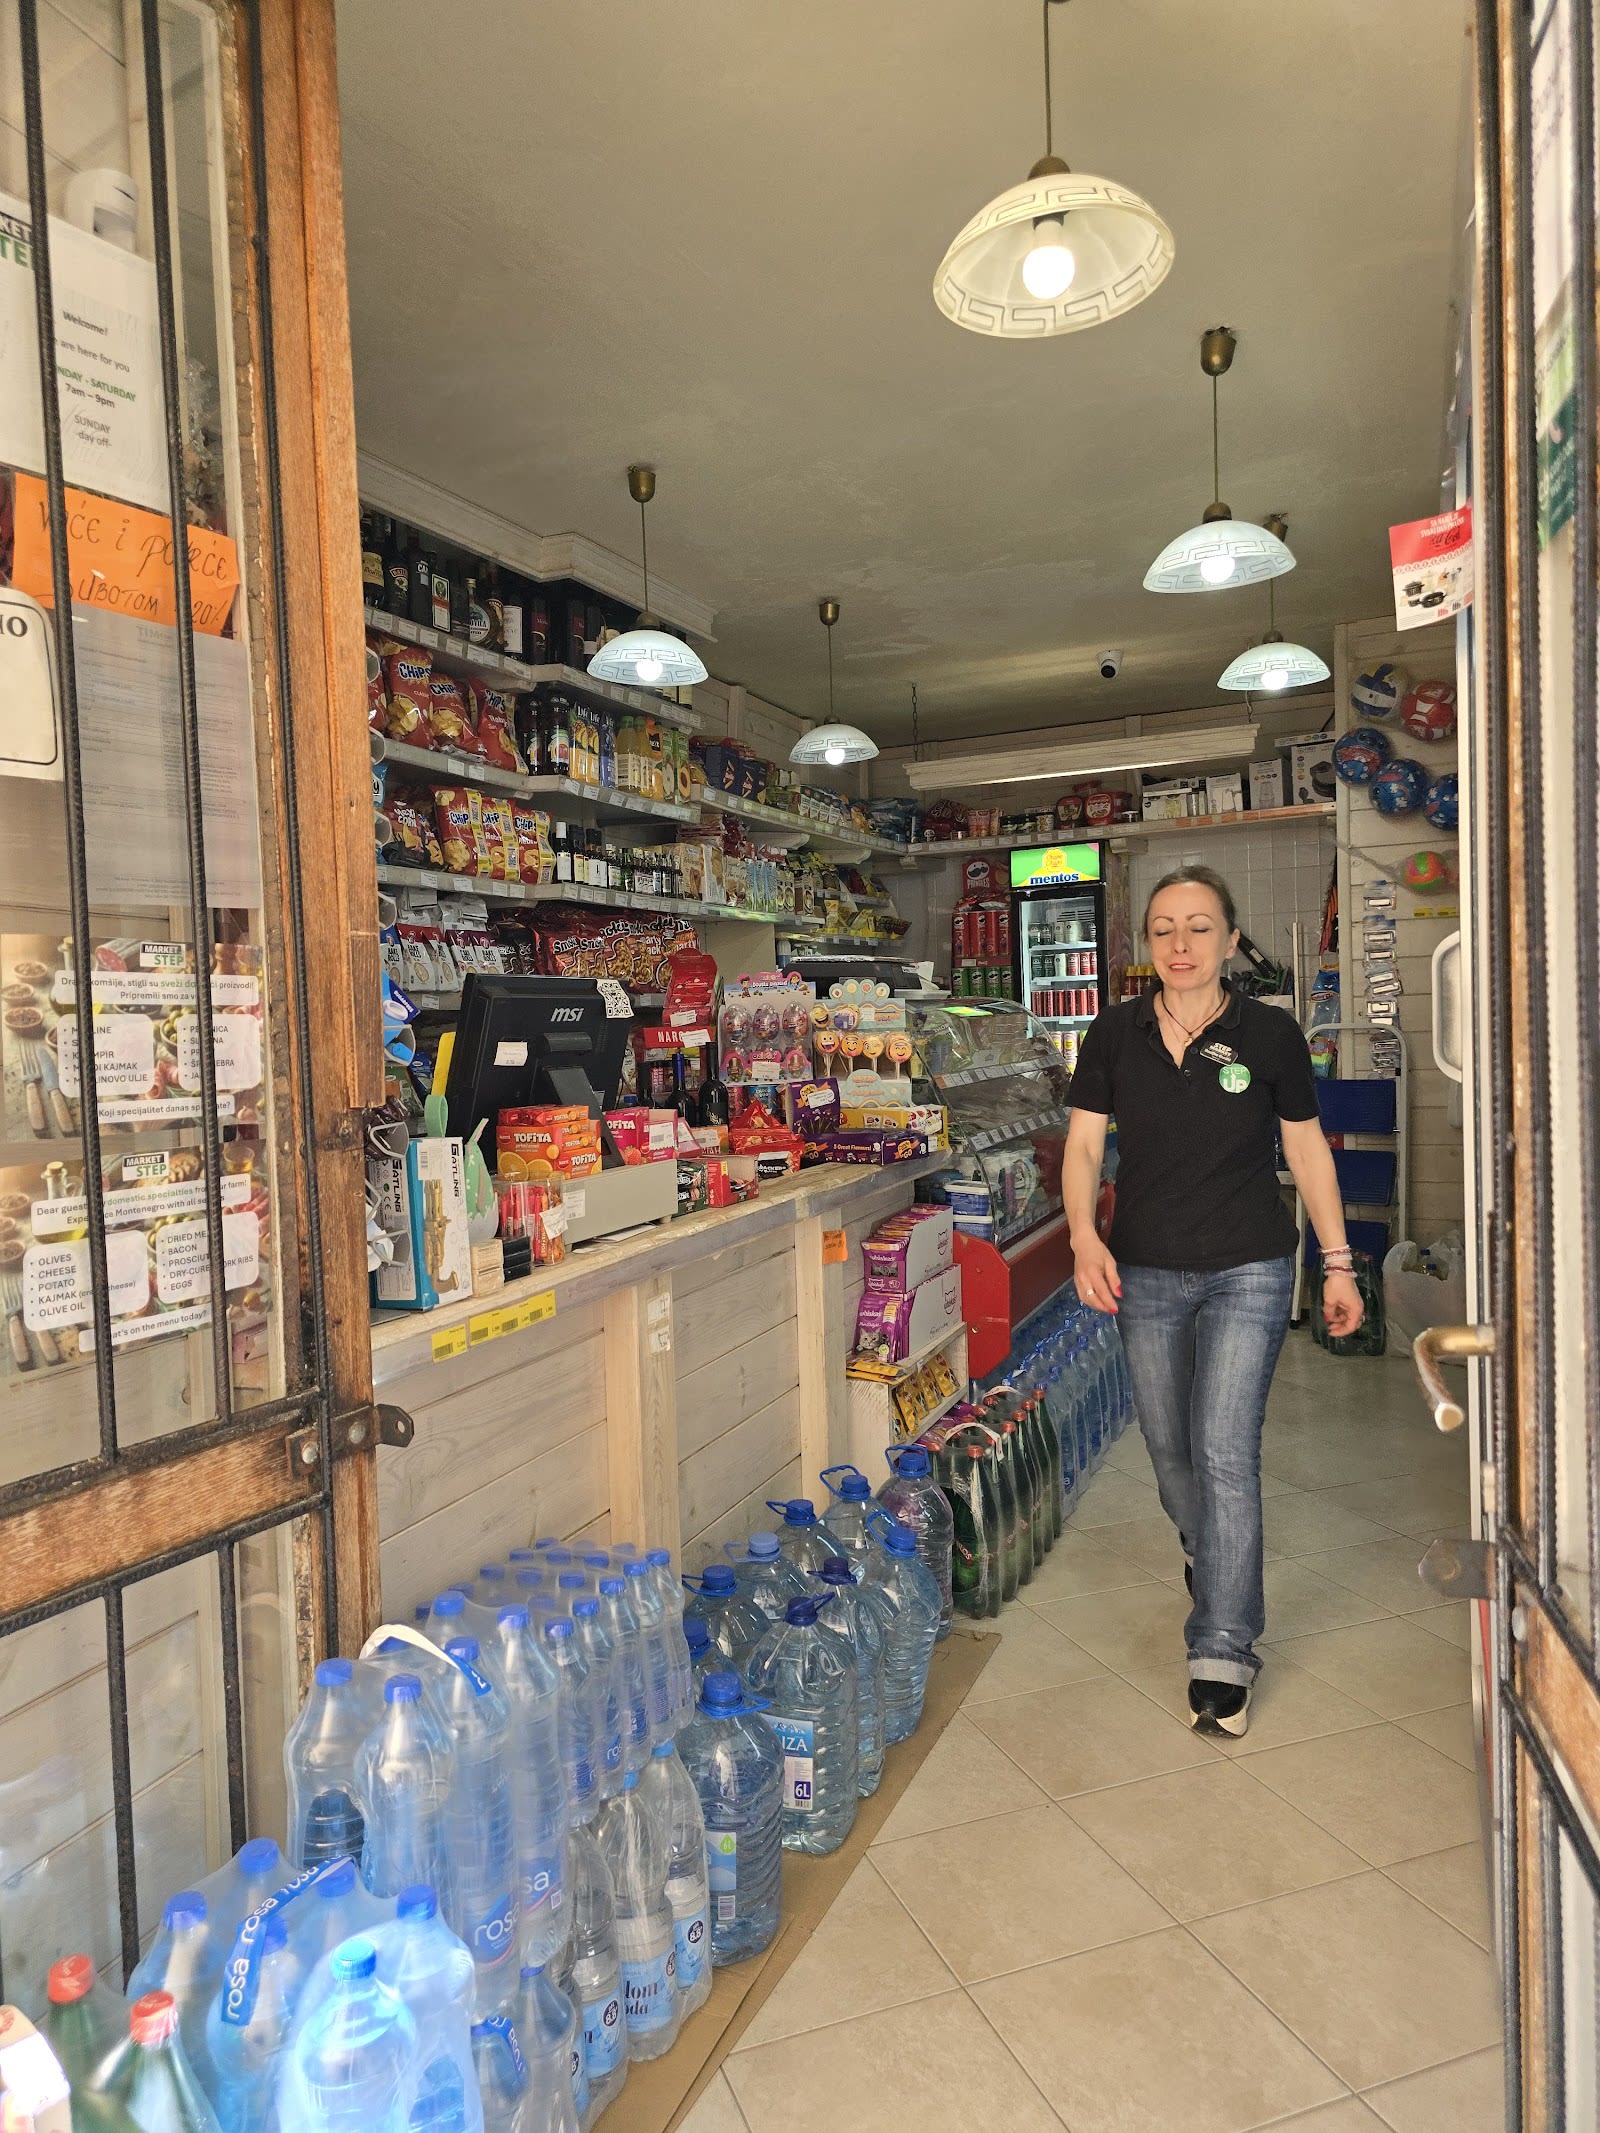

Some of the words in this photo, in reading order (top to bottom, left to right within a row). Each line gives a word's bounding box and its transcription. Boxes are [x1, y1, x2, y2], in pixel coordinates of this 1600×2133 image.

[62, 310, 108, 336] Welcome!
[60, 340, 76, 352] are
[77, 346, 98, 361] here
[100, 352, 113, 367] for
[114, 359, 130, 373] you
[56, 365, 83, 383] NDAY
[91, 378, 137, 402] SATURDAY
[65, 382, 85, 397] 7am
[95, 393, 115, 409] 9pm
[74, 414, 111, 434] SUNDAY
[1029, 872, 1080, 886] mentos
[144, 945, 180, 954] MARKET
[154, 955, 184, 966] STEP
[127, 978, 148, 989] stigli
[550, 1007, 585, 1022] msi
[104, 1062, 138, 1071] KAJMAK
[128, 1073, 149, 1083] ULJE
[99, 1109, 115, 1118] Koji
[116, 1106, 165, 1118] specijalitet
[165, 1104, 190, 1113] danas
[126, 1155, 163, 1166] MARKET
[136, 1164, 167, 1177] STEP
[451, 1143, 461, 1198] GATLING
[36, 1206, 59, 1216] Dear
[61, 1203, 88, 1214] guest
[107, 1194, 146, 1206] domestic
[147, 1186, 193, 1200] specialties
[228, 1180, 247, 1189] farm!
[115, 1203, 165, 1219] Montenegro
[167, 1199, 185, 1209] with
[186, 1198, 196, 1207] all
[167, 1233, 193, 1244] DRIED
[168, 1244, 198, 1255] BACON
[38, 1253, 72, 1266] OLIVES
[168, 1253, 210, 1268] PROSCIUT
[169, 1264, 210, 1279] DRY-CURE
[237, 1255, 254, 1265] RIBS
[38, 1265, 77, 1279] CHEESE
[38, 1278, 75, 1292] POTATO
[170, 1280, 193, 1291] EGGS
[38, 1290, 77, 1305] KAJMAK
[39, 1304, 68, 1318] OLIVE
[69, 1302, 86, 1312] OIL
[130, 1327, 141, 1336] on
[141, 1322, 156, 1333] the
[156, 1317, 180, 1329] menu
[181, 1309, 207, 1323] today?
[795, 1782, 811, 1798] 6L
[240, 1897, 280, 1944] rosa
[226, 1957, 250, 2020] rosa
